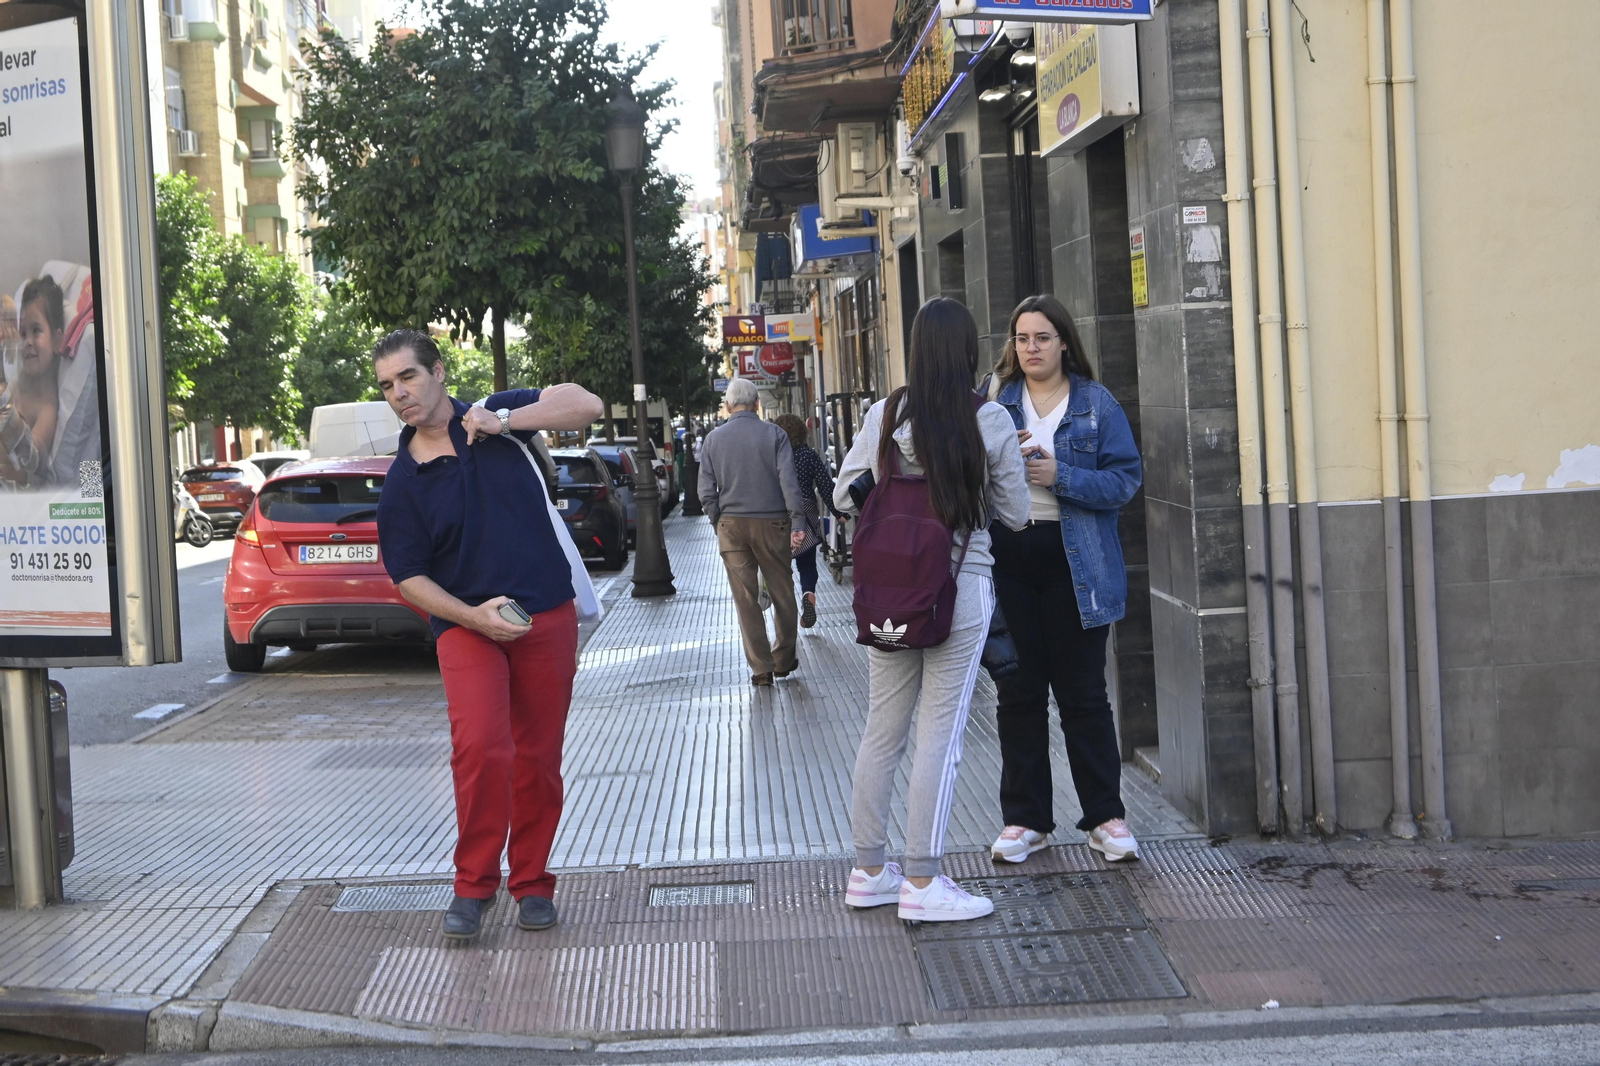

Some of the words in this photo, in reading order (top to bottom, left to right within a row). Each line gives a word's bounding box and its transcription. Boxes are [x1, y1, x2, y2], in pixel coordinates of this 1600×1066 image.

[1073, 32, 1097, 79] CALZADO
[2, 77, 66, 104] sonrisas
[51, 508, 80, 516] Dedúcete
[81, 507, 86, 515] el
[87, 506, 101, 515] 80%
[51, 525, 105, 545] SOCIO!
[10, 552, 24, 570] 91
[28, 552, 49, 570] 431
[53, 552, 70, 570] 25
[74, 552, 92, 570] 90
[307, 547, 342, 559] 8214
[347, 546, 373, 558] GHS
[11, 573, 93, 583] doctorsonrisa@theodora.org
